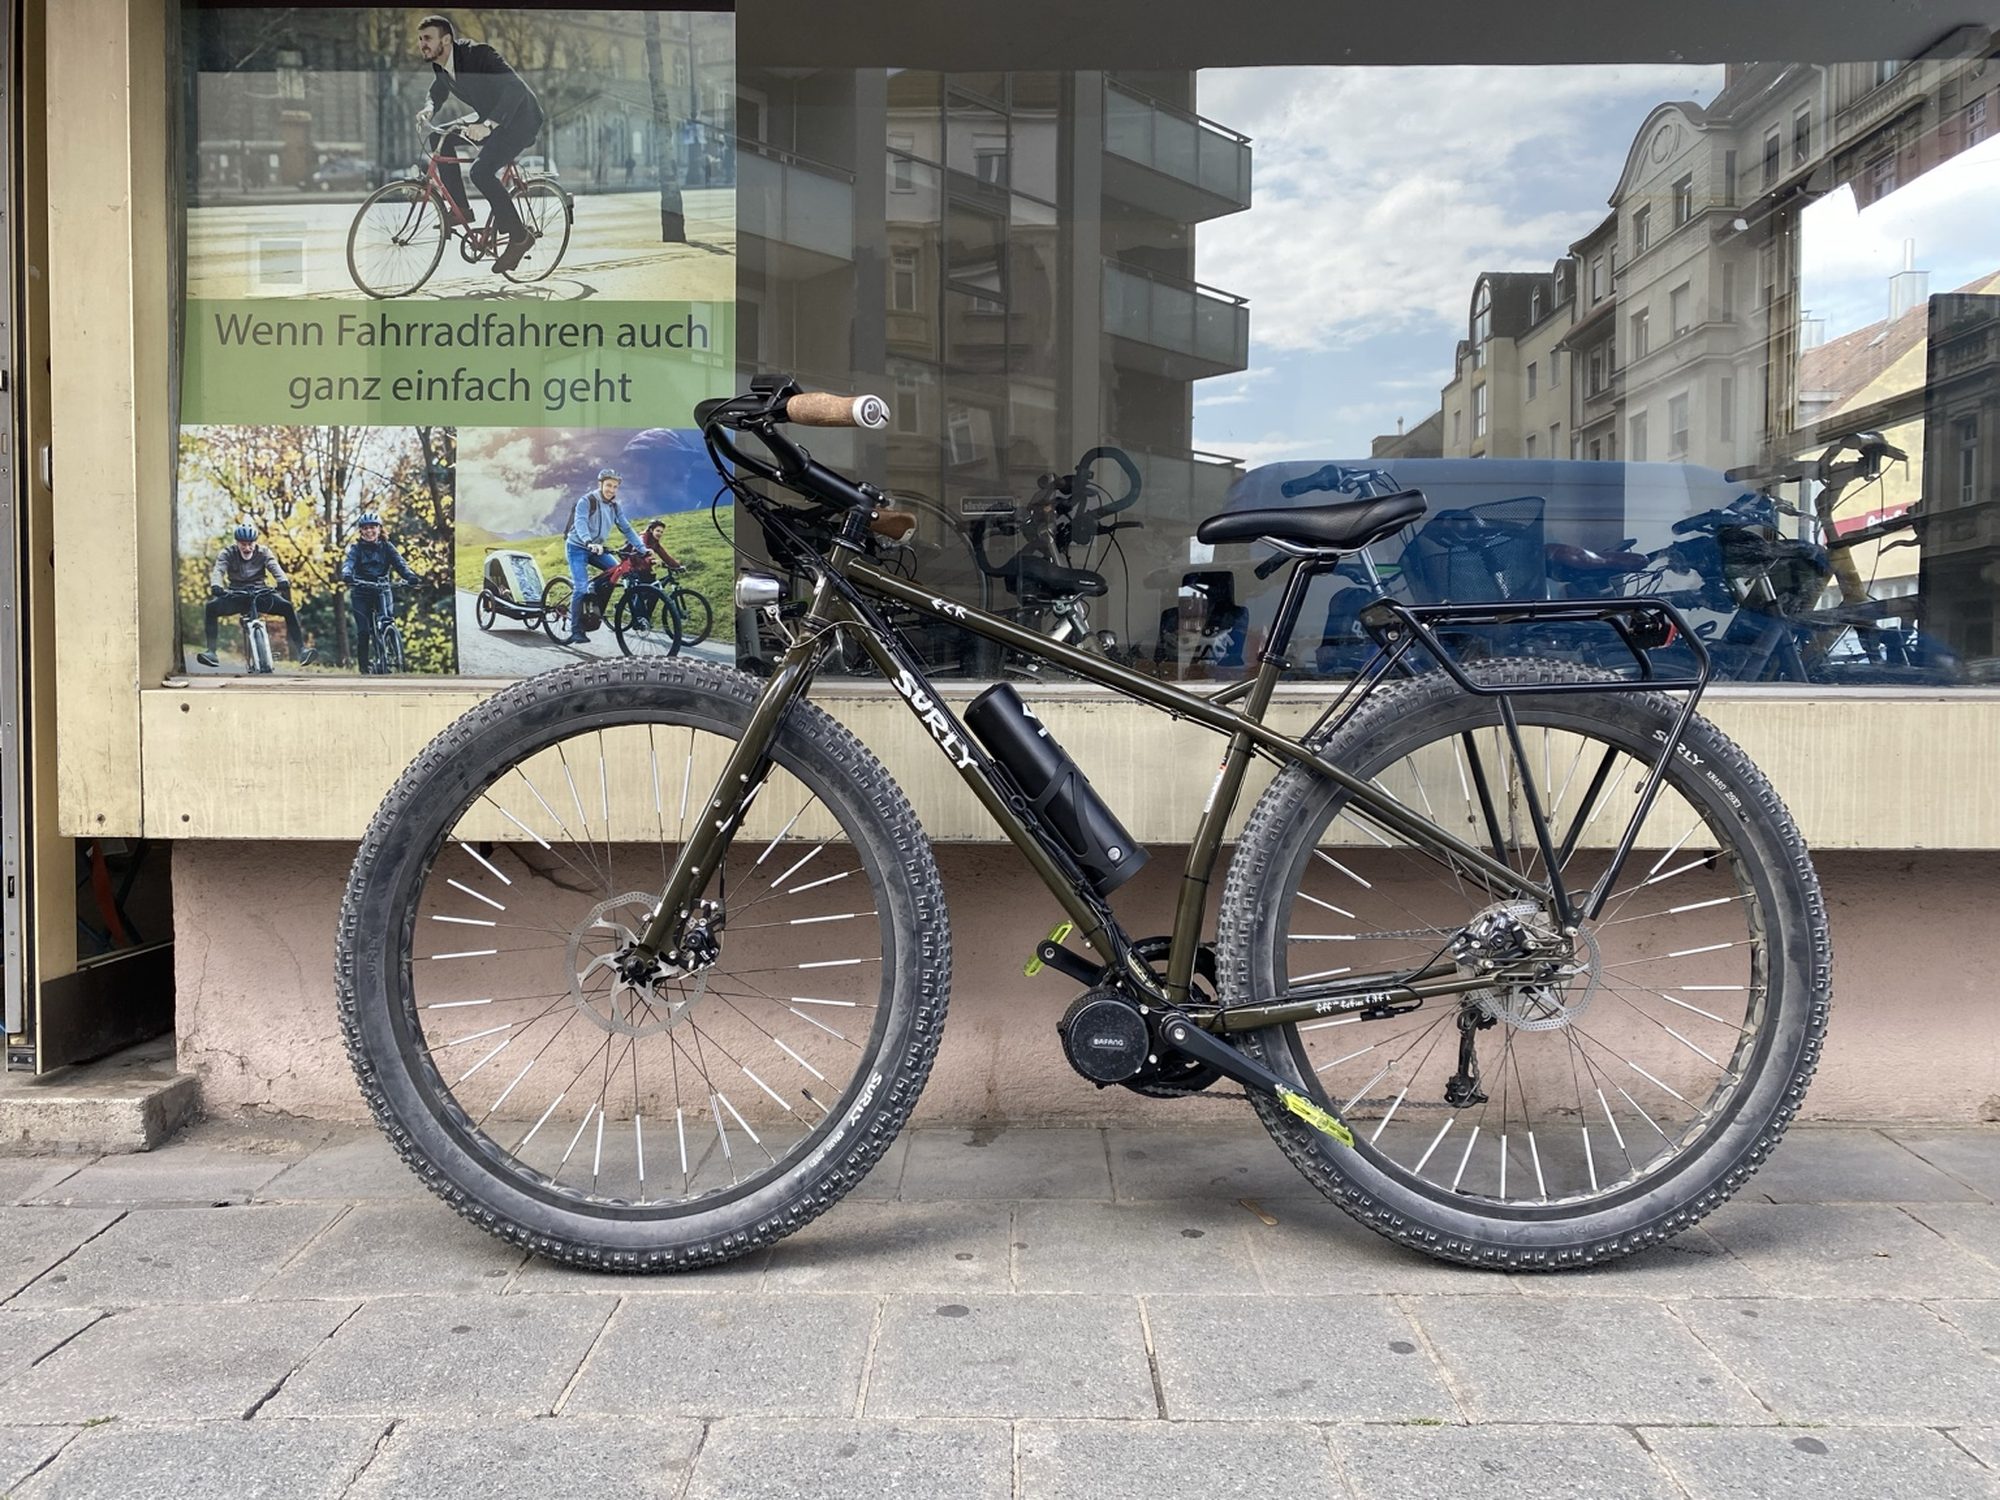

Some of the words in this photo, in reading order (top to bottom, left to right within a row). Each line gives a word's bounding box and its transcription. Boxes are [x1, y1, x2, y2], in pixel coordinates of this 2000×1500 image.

[215, 314, 324, 346] Wenn
[337, 313, 604, 348] Fahrradfahren
[617, 315, 709, 349] auch
[289, 374, 381, 409] ganz
[391, 368, 531, 402] einfach
[543, 368, 632, 411] geht
[892, 669, 978, 769] SURLY
[1652, 729, 1704, 766] SRLY
[849, 1072, 882, 1127] SURLY
